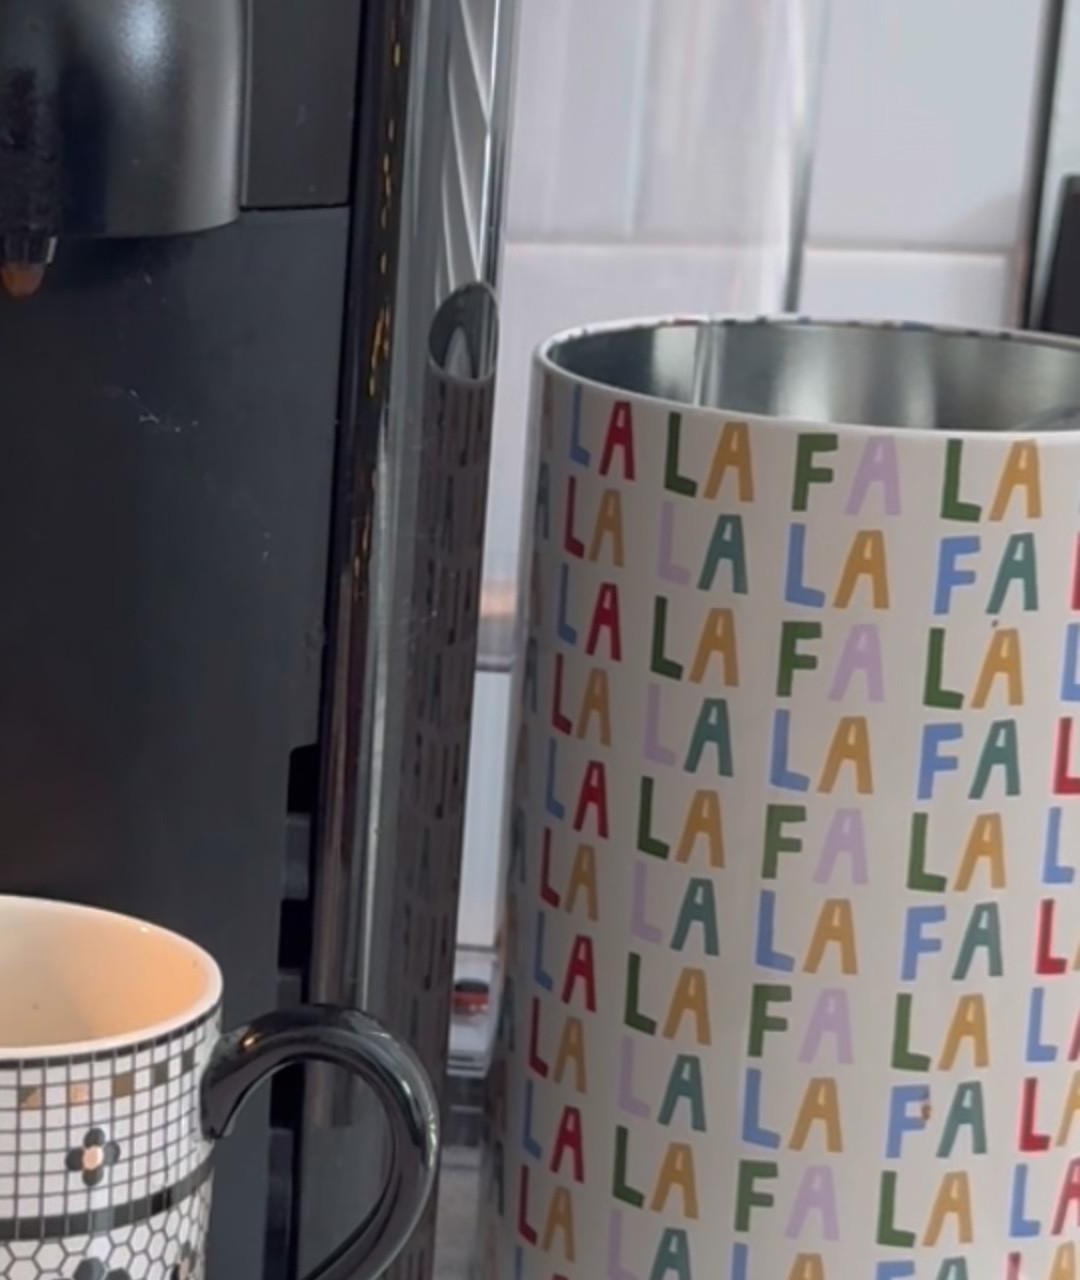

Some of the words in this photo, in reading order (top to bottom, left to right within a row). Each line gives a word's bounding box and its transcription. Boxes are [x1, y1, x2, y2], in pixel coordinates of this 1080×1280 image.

[569, 385, 635, 480] LA
[664, 412, 754, 502] LA
[792, 433, 901, 515] FA
[940, 438, 1042, 523] LA
[563, 475, 624, 568] LA
[657, 500, 748, 595] LA
[784, 523, 890, 609] LA
[931, 532, 1039, 616] FA
[556, 563, 621, 661] LA
[650, 596, 739, 687] LA
[776, 621, 885, 703] FA
[923, 627, 1024, 710] LA
[551, 653, 611, 747] LA
[643, 682, 733, 777] LA
[769, 709, 873, 795] LA
[915, 719, 1021, 802] FA
[545, 738, 608, 839] LA
[637, 776, 724, 868] LA
[761, 804, 869, 886] FA
[906, 812, 1006, 893] LA
[539, 826, 598, 921] LA
[631, 861, 719, 956] LA
[755, 890, 858, 974] LA
[900, 902, 1003, 981] FA
[533, 910, 596, 1012] LA
[624, 953, 711, 1046] LA
[748, 984, 854, 1065] FA
[891, 993, 990, 1072] LA
[529, 996, 587, 1093] LA
[620, 1036, 707, 1132] LA
[741, 1068, 843, 1152] LA
[885, 1081, 987, 1159] FA
[517, 1165, 576, 1263] LA
[523, 1081, 584, 1183] LA
[612, 1126, 699, 1219] LA
[734, 1160, 839, 1241] FA
[876, 1170, 974, 1248] LA
